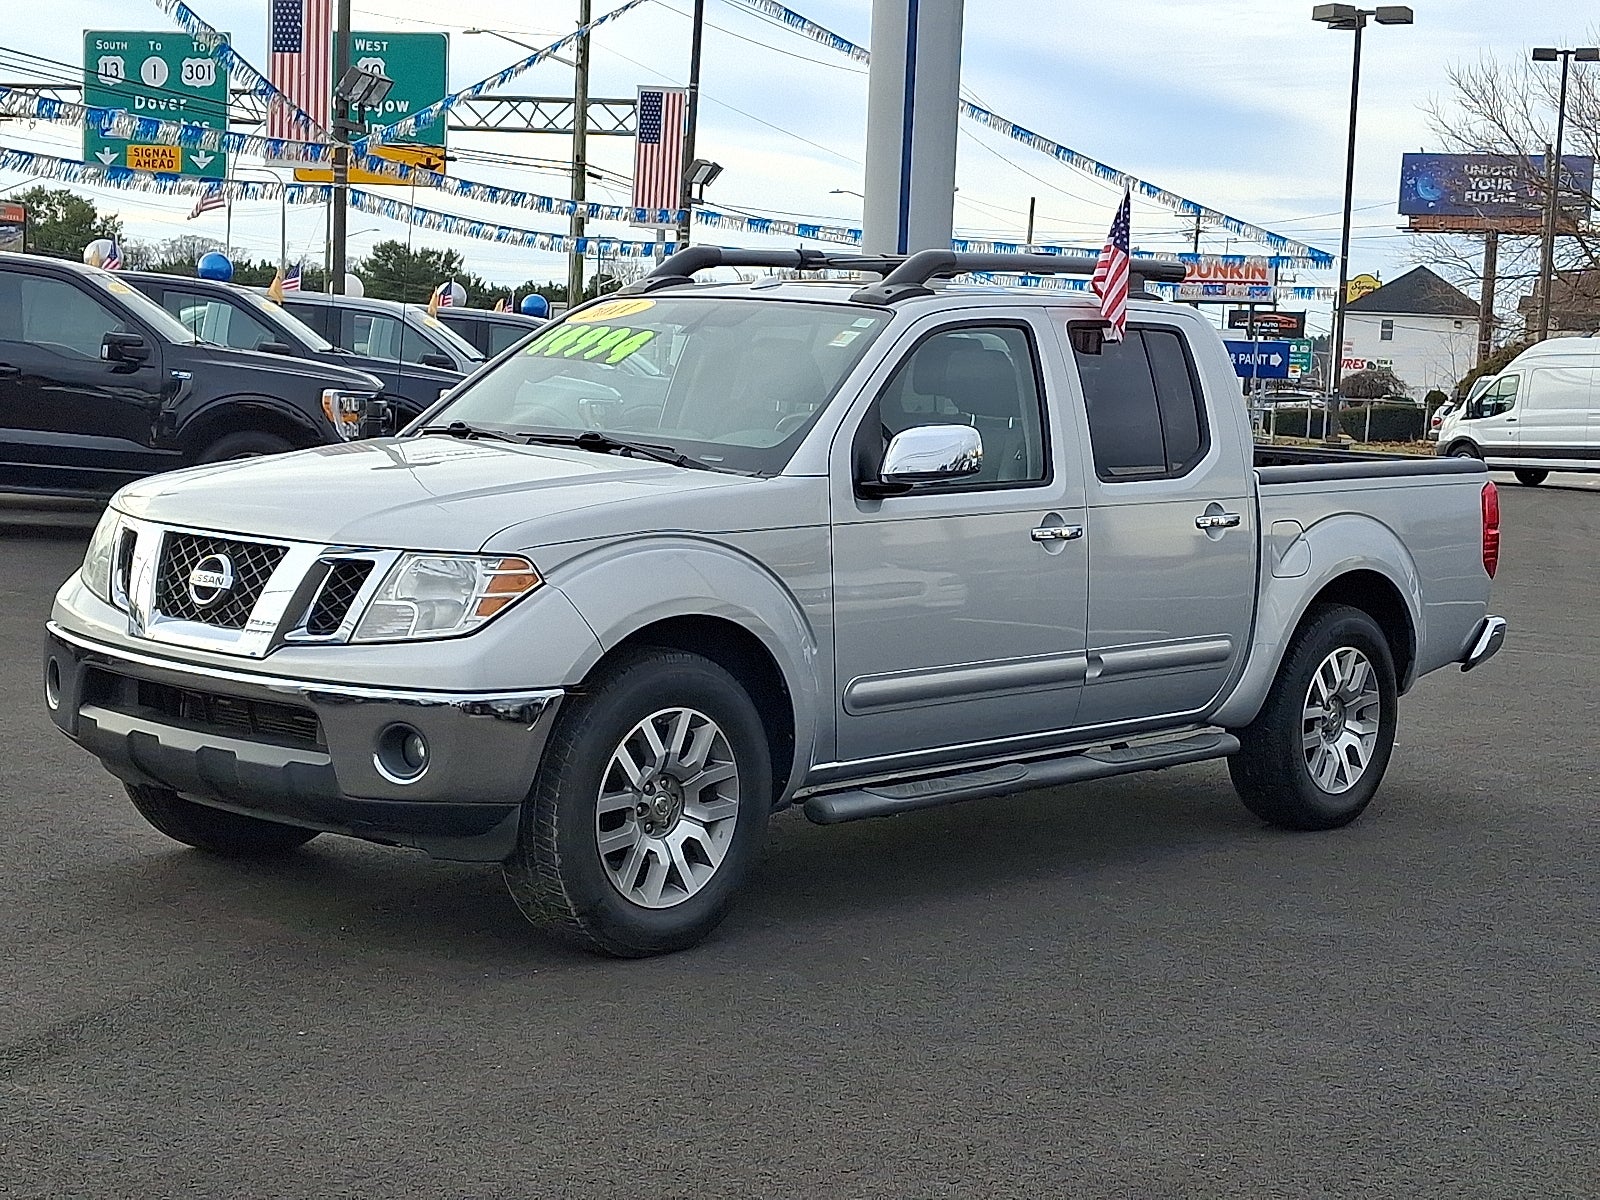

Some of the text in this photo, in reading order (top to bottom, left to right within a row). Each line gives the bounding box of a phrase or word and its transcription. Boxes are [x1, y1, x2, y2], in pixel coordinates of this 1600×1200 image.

[96, 40, 127, 50] SOUTH
[355, 39, 388, 51] WEST
[104, 62, 212, 80] 13 1 301
[134, 96, 187, 110] Dover
[133, 147, 175, 158] SIGNAL
[135, 159, 174, 169] AHEAD
[1468, 178, 1512, 190] YOUR
[1464, 191, 1517, 203] FUTURE
[1238, 353, 1268, 366] PAINT
